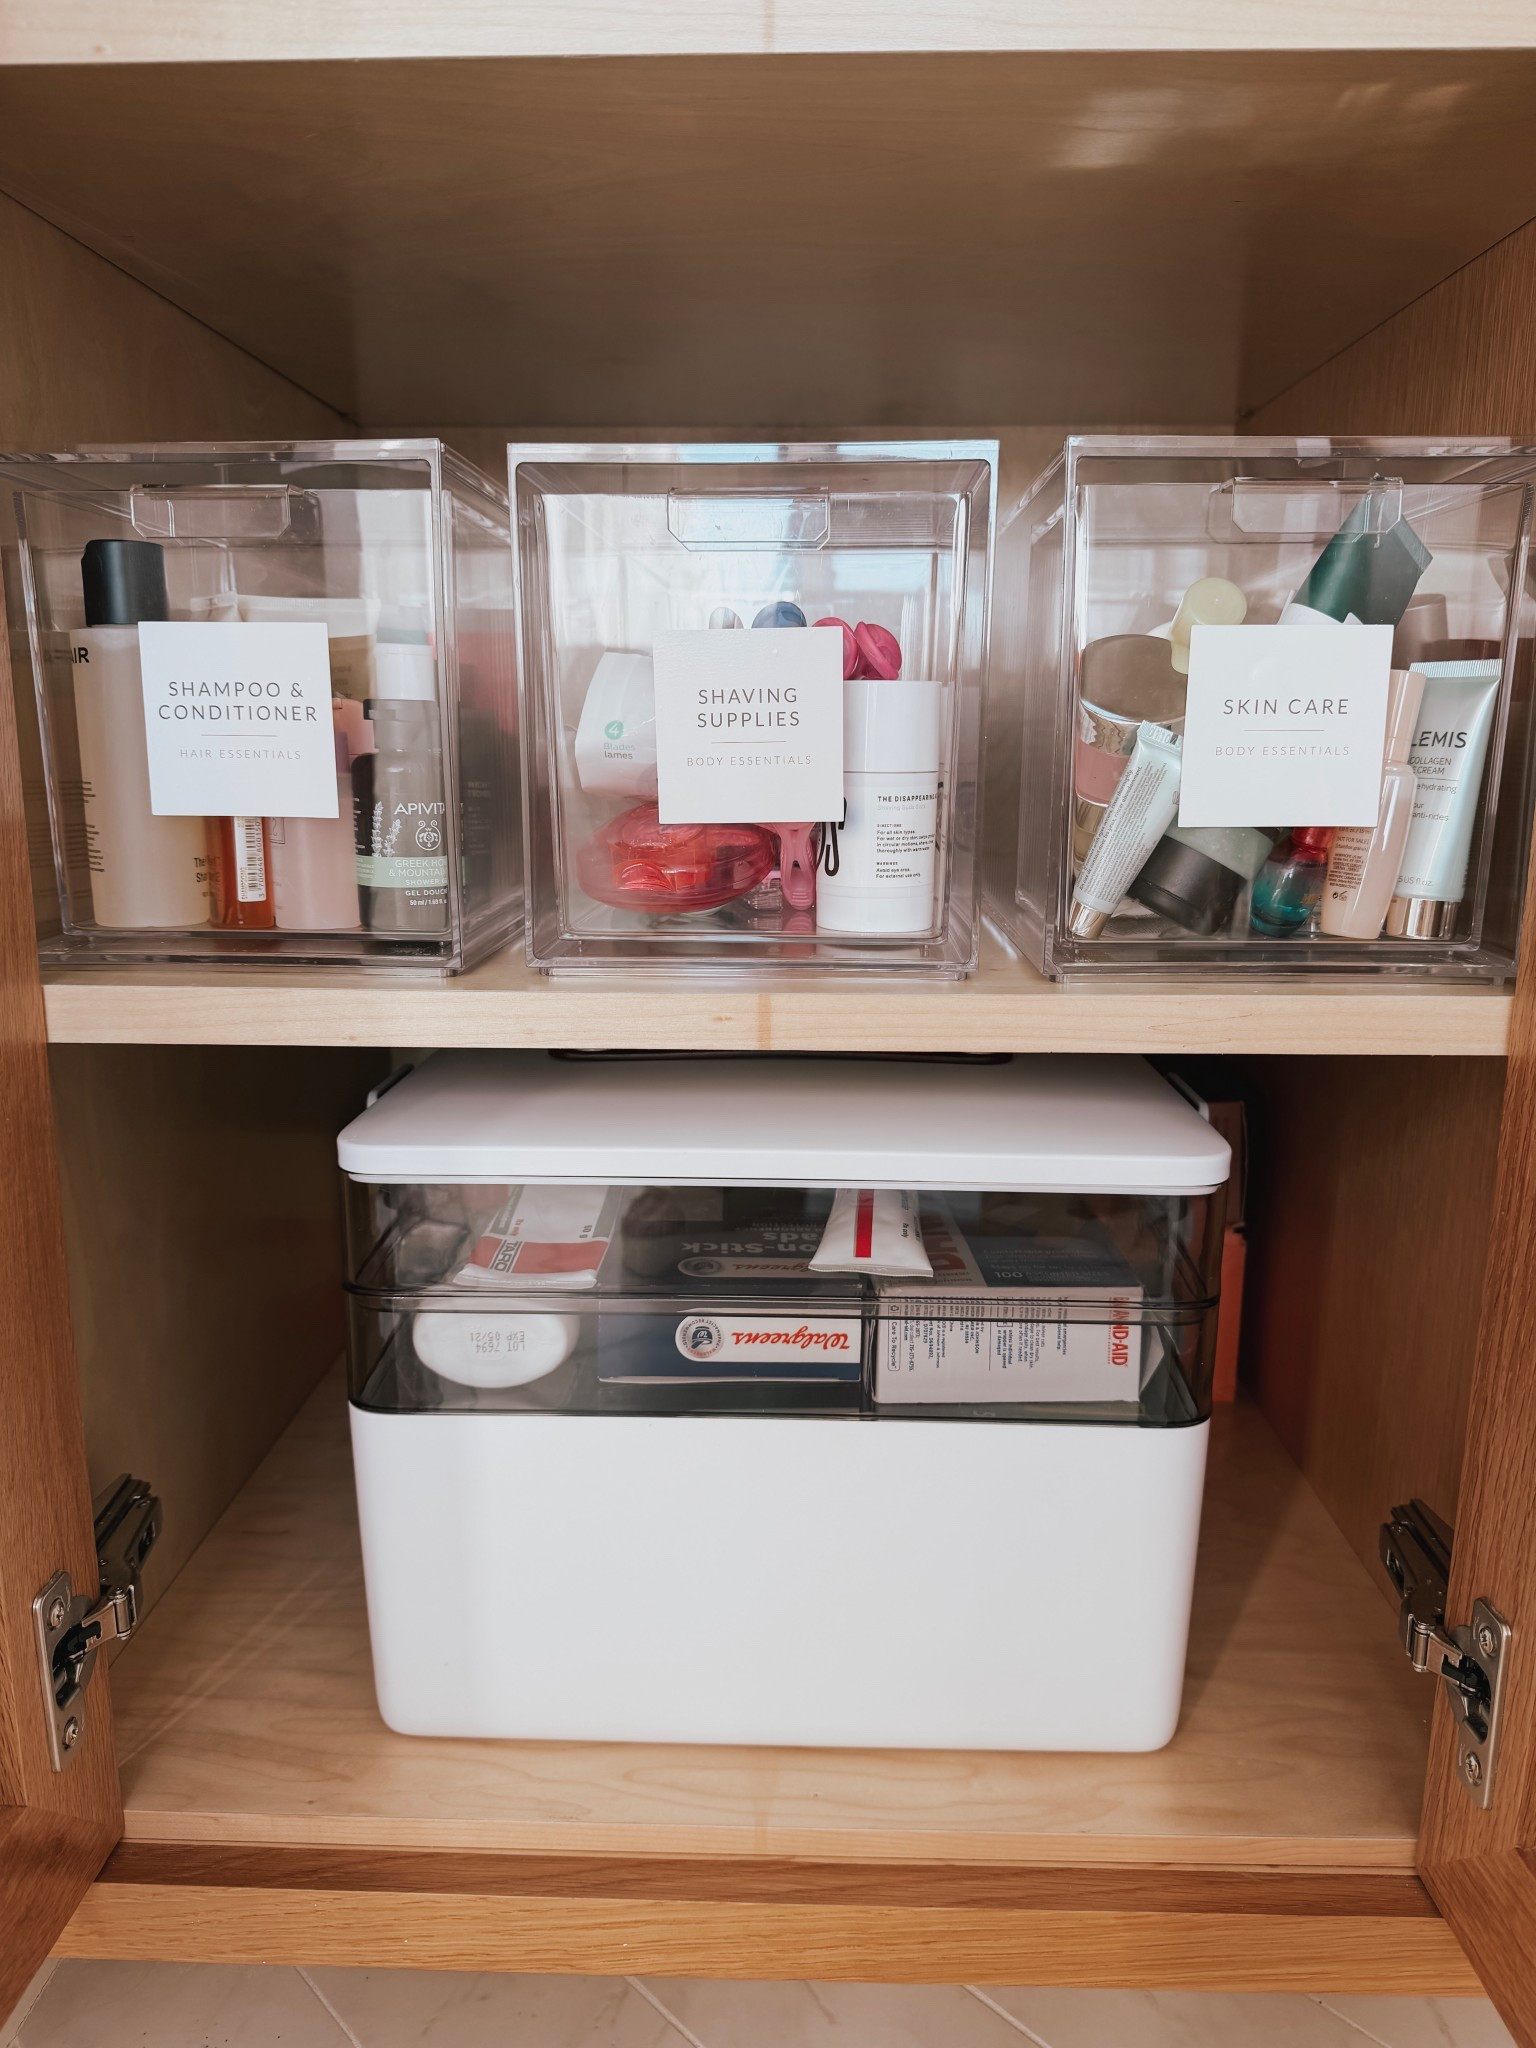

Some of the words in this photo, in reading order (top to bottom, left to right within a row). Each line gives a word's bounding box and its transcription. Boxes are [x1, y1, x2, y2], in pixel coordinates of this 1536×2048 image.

[169, 681, 280, 698] SHAMPOO
[290, 682, 304, 698] &
[698, 687, 798, 705] SHAVING
[158, 704, 317, 721] CONDITIONER
[1223, 698, 1278, 715] SKIN
[1288, 698, 1349, 715] CARE
[697, 711, 800, 728] SUPPLIES
[608, 722, 619, 737] 4
[603, 742, 635, 751] Blades
[1215, 746, 1255, 756] BODY
[1262, 746, 1350, 756] ESSENTIALS
[180, 749, 212, 758] HAIR
[219, 749, 301, 760] ESSENTIALS
[604, 750, 633, 760] lames
[687, 757, 723, 767] BODY
[730, 755, 812, 766] ESSENTIALS
[1417, 766, 1445, 775] CREAM
[1412, 811, 1449, 822] anti-rides
[395, 859, 430, 869] GREEK
[431, 859, 447, 869] HO
[389, 869, 396, 877] &
[399, 869, 447, 877] MOUNTAI
[762, 1232, 818, 1243] ads
[682, 1242, 817, 1254] on-Stick
[494, 1242, 519, 1272] TARO
[733, 1261, 812, 1273] lgreens
[994, 1271, 1023, 1279] 100
[506, 1330, 525, 1341] EXP
[731, 1325, 850, 1350] Walgreens
[507, 1340, 525, 1352] LOT
